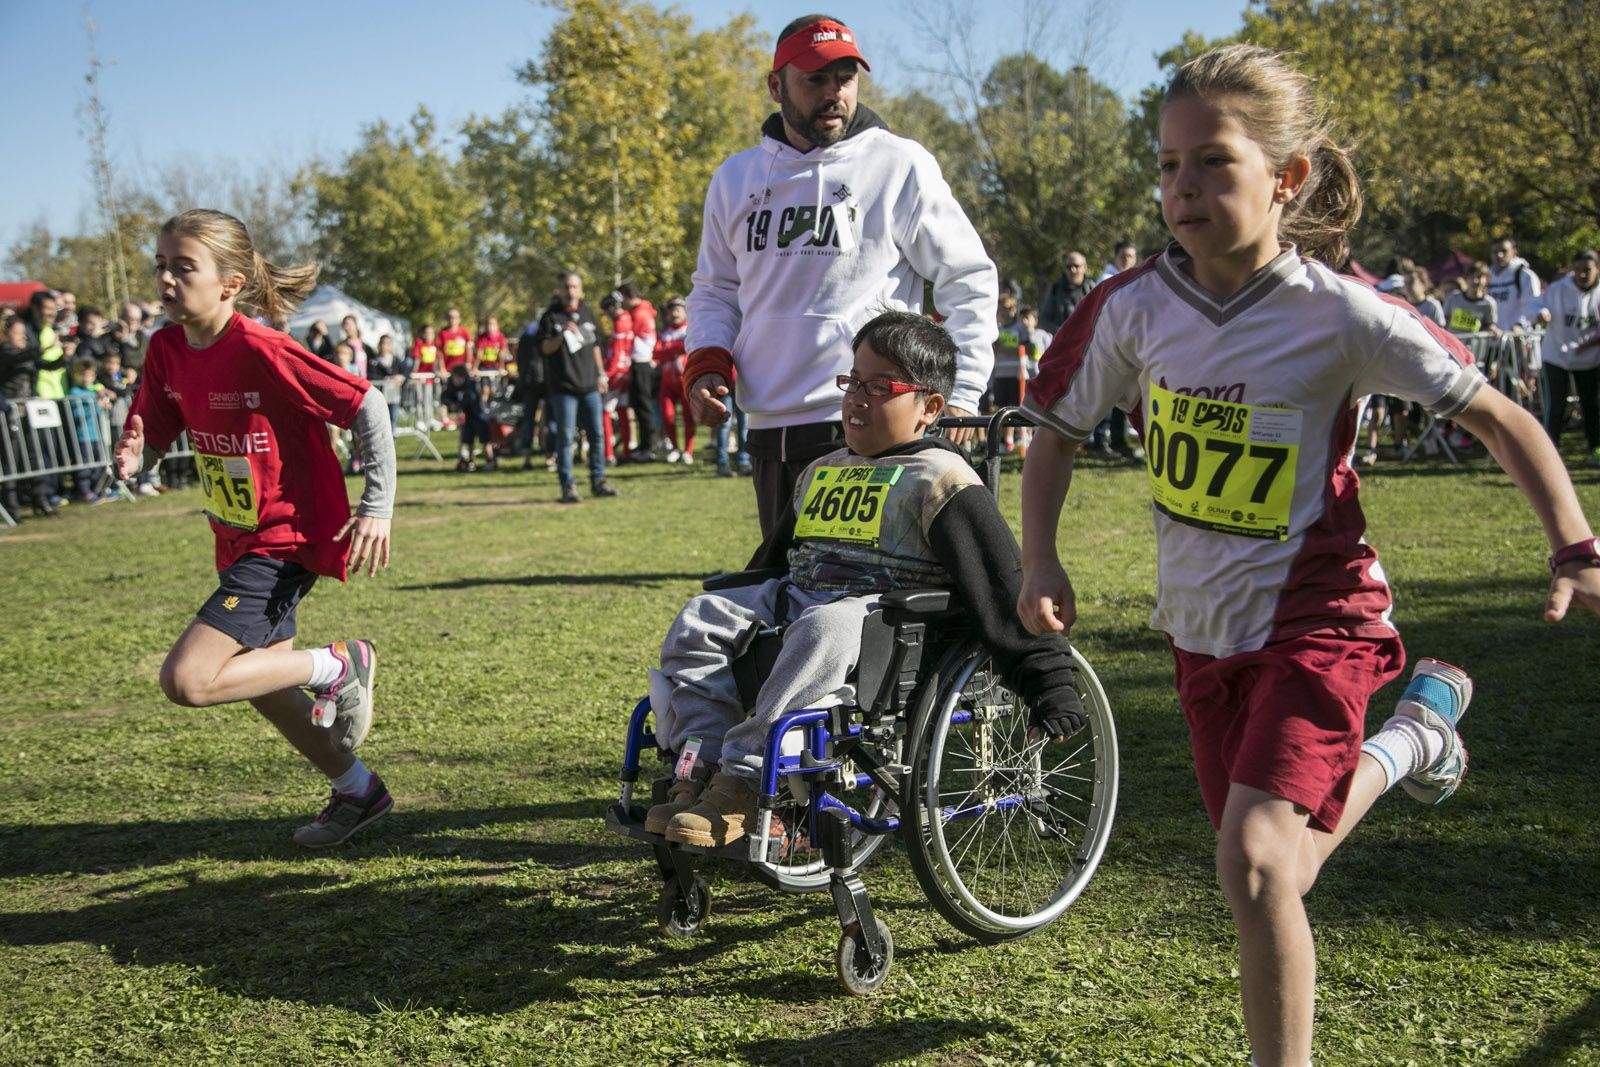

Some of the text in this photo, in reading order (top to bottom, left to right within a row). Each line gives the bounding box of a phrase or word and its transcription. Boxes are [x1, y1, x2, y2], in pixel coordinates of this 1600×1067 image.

[747, 209, 772, 252] 19
[1171, 398, 1190, 424] 19
[1192, 402, 1248, 433] CROS
[1148, 420, 1289, 504] 0077
[804, 485, 883, 522] 4605
